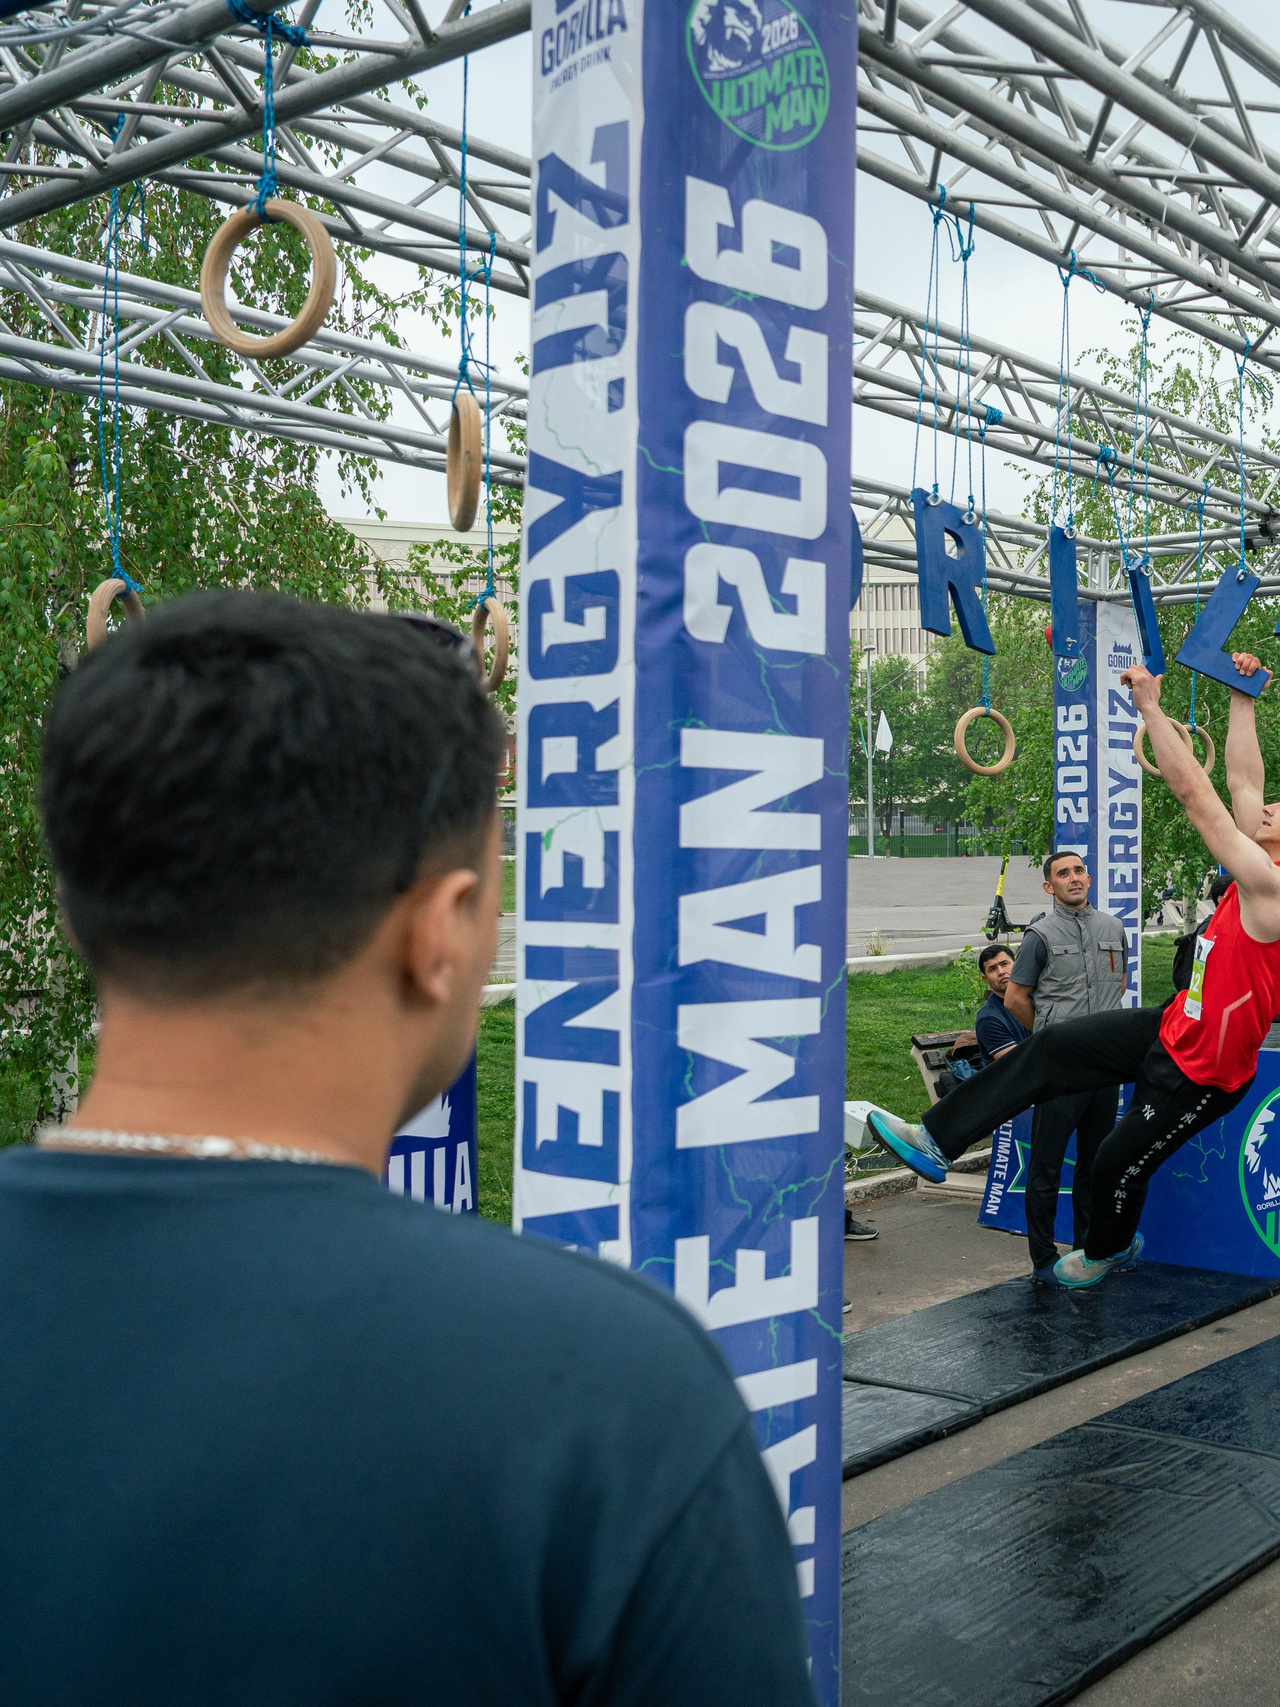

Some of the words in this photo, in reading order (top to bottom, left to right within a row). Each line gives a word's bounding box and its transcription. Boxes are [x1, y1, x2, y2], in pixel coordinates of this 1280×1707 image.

[541, 0, 628, 77] GORILLA
[761, 12, 799, 55] 2026
[712, 48, 825, 118] ULTIMATE
[765, 86, 825, 143] MAN
[683, 175, 829, 656] 2026
[1056, 703, 1089, 824] 2026
[675, 728, 824, 1149] MAN
[388, 1140, 473, 1216] ILLA
[984, 1182, 1005, 1216] MAN
